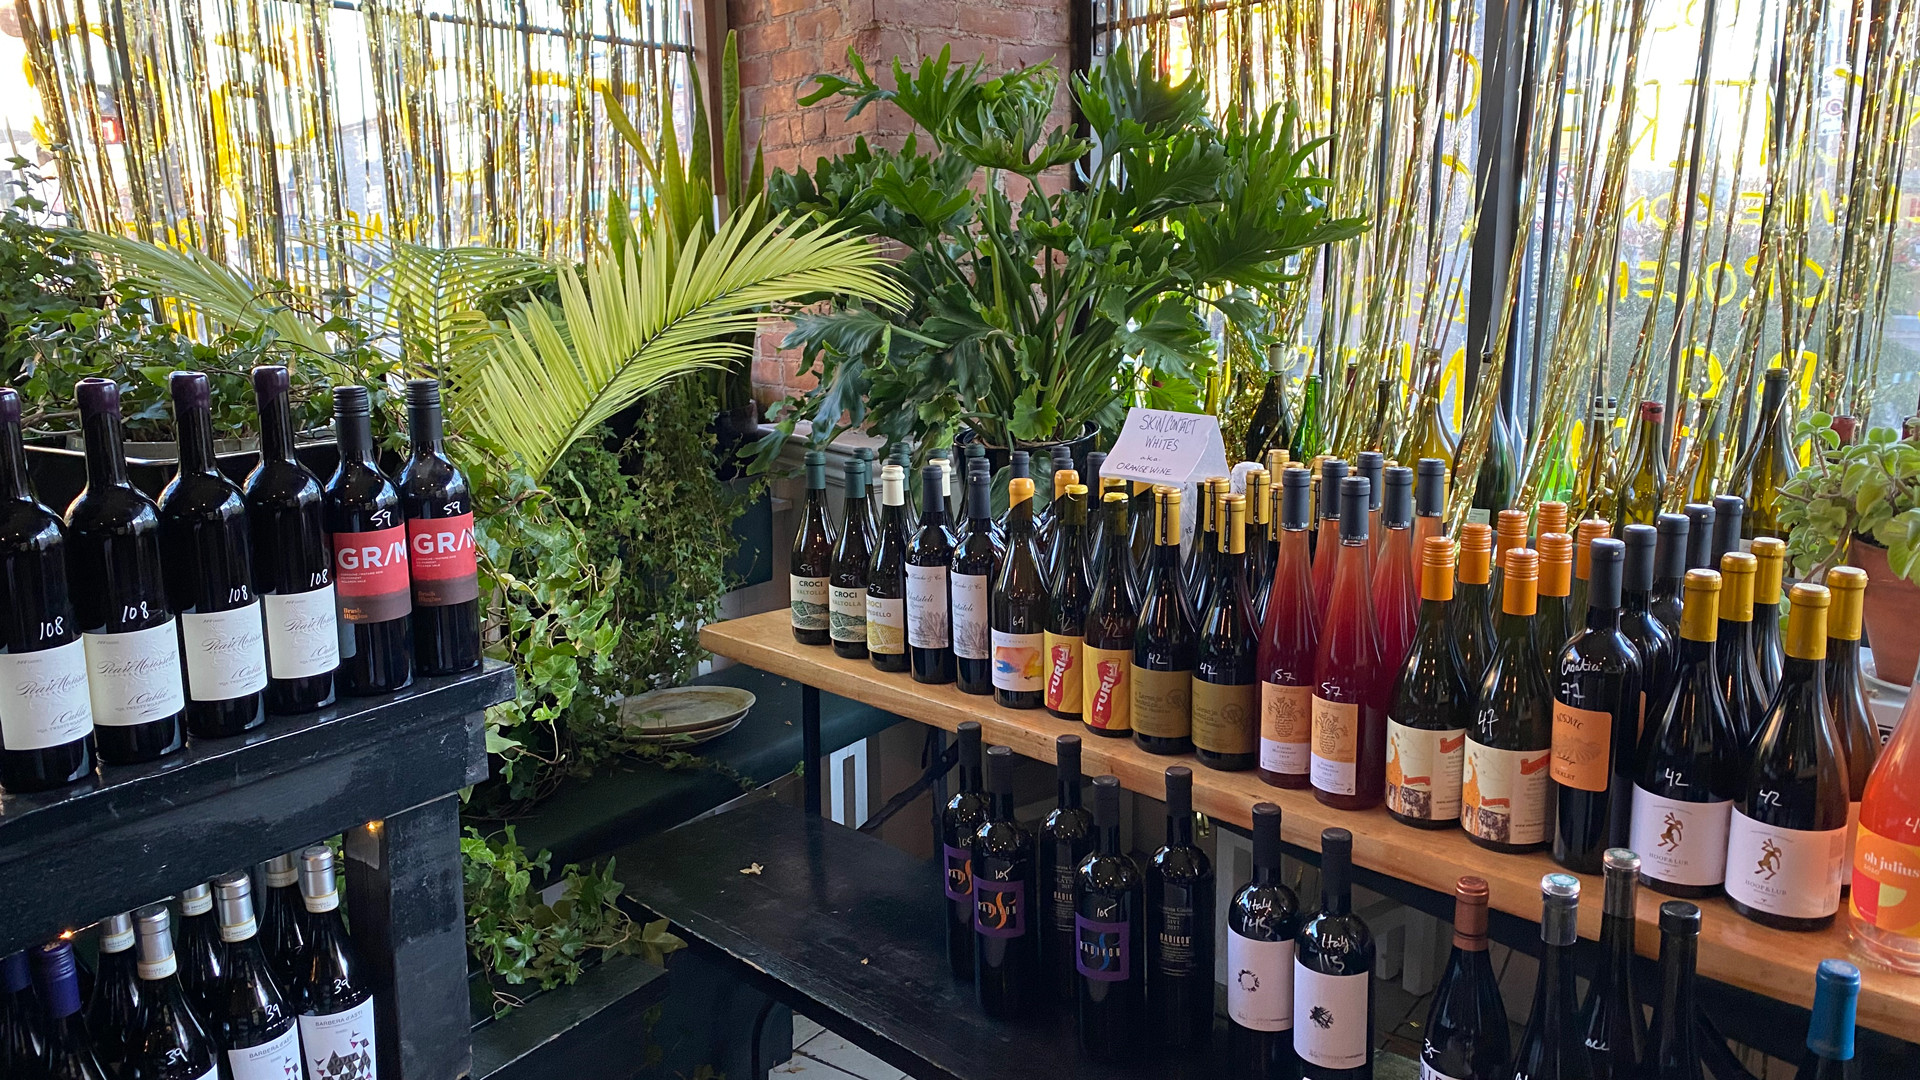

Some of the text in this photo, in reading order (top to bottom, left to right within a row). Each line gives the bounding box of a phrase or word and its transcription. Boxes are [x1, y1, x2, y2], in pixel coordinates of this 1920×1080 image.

[1139, 414, 1201, 435] SKIN CONTACT
[1145, 435, 1180, 452] WHITES
[1116, 462, 1173, 476] ORANGE WINE
[443, 501, 462, 515] 59
[370, 508, 392, 527] 59
[911, 554, 921, 566] 34
[310, 569, 328, 587] 108
[800, 563, 814, 576] 59
[840, 574, 855, 587] 59
[869, 583, 887, 595] 52
[228, 584, 248, 603] 108
[834, 590, 857, 598] CROCI
[121, 601, 150, 623] 108
[39, 616, 65, 641] 108
[1012, 615, 1025, 628] 64
[1148, 652, 1168, 665] 42
[1561, 656, 1601, 676] Croatia
[1051, 659, 1067, 694] TURI
[1199, 662, 1218, 675] 42
[1274, 668, 1296, 682] 57
[1096, 675, 1116, 712] TURI
[1321, 681, 1343, 697] 57
[1561, 682, 1586, 706] 77
[1477, 708, 1499, 737] 47
[1665, 767, 1689, 787] 42
[1759, 789, 1782, 807] 42
[958, 836, 973, 849] 105
[995, 864, 1014, 882] 105
[1864, 851, 1920, 878] oh julius
[1096, 903, 1118, 918] 105
[1247, 897, 1272, 912] Italy
[1160, 933, 1190, 944] RADIKON
[1321, 933, 1349, 953] Italy
[333, 978, 351, 995] 39
[265, 1003, 281, 1023] 39
[315, 1015, 344, 1027] BARBERA
[165, 1047, 188, 1066] 39
[249, 1043, 279, 1059] BARBERA
